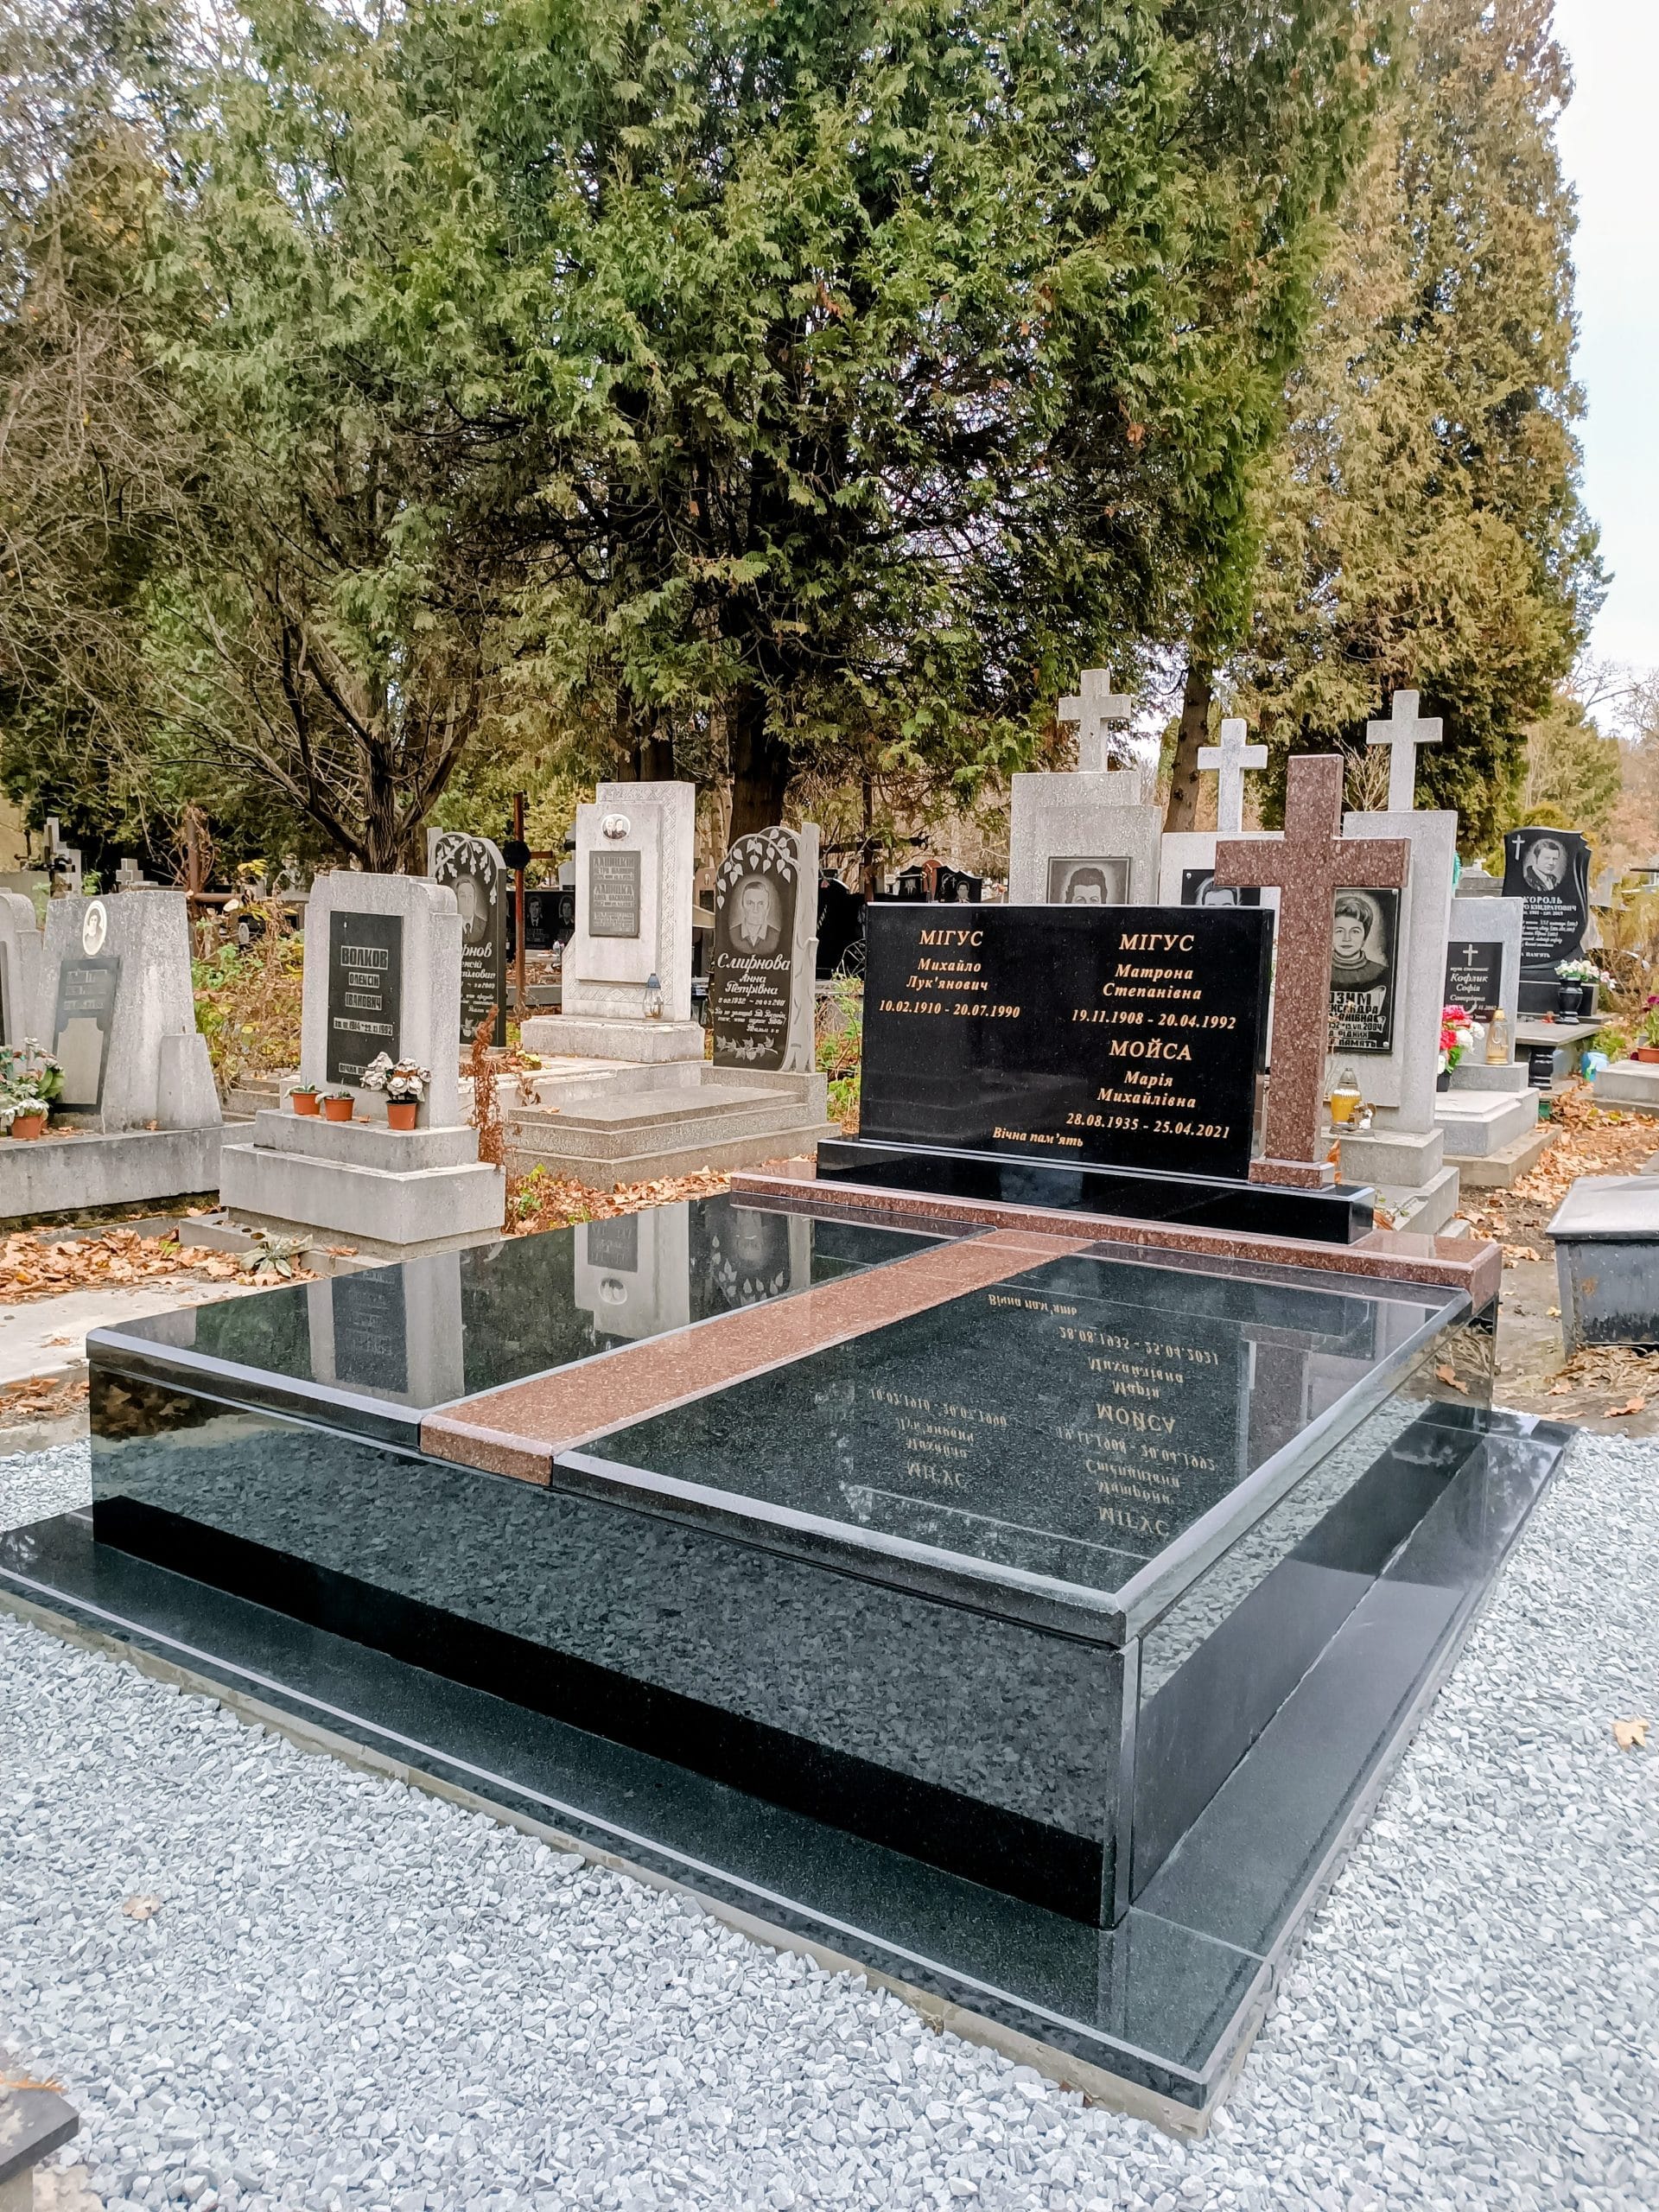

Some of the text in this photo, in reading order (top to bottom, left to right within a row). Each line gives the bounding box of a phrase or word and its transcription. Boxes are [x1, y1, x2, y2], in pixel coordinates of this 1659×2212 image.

[918, 930, 983, 946] МІГУС
[1119, 934, 1194, 951] МІГУС
[341, 948, 387, 969] ВОЛКОВ
[717, 953, 791, 973] Смирнова
[918, 957, 982, 972] Михайло
[739, 974, 766, 982] Анна
[1115, 963, 1193, 982] Матрона
[1450, 974, 1488, 984] Кофлик
[725, 981, 779, 996] Петрівна
[906, 976, 988, 991] Лук'янович
[1103, 982, 1202, 1000] Степанівна
[879, 1000, 942, 1014] 10.02.1910
[953, 1003, 1020, 1018] 20.07.1990
[1071, 1009, 1144, 1025] 19.11.1908
[1158, 1014, 1236, 1029] 20.04.1992
[1109, 1038, 1192, 1061] МОЙСА
[1124, 1071, 1173, 1089] Марія
[1096, 1088, 1196, 1109] Михайлівна
[993, 1127, 1027, 1141] Вічна
[1066, 1113, 1140, 1130] 28.08.1935
[1154, 1121, 1230, 1139] 25.04.2021
